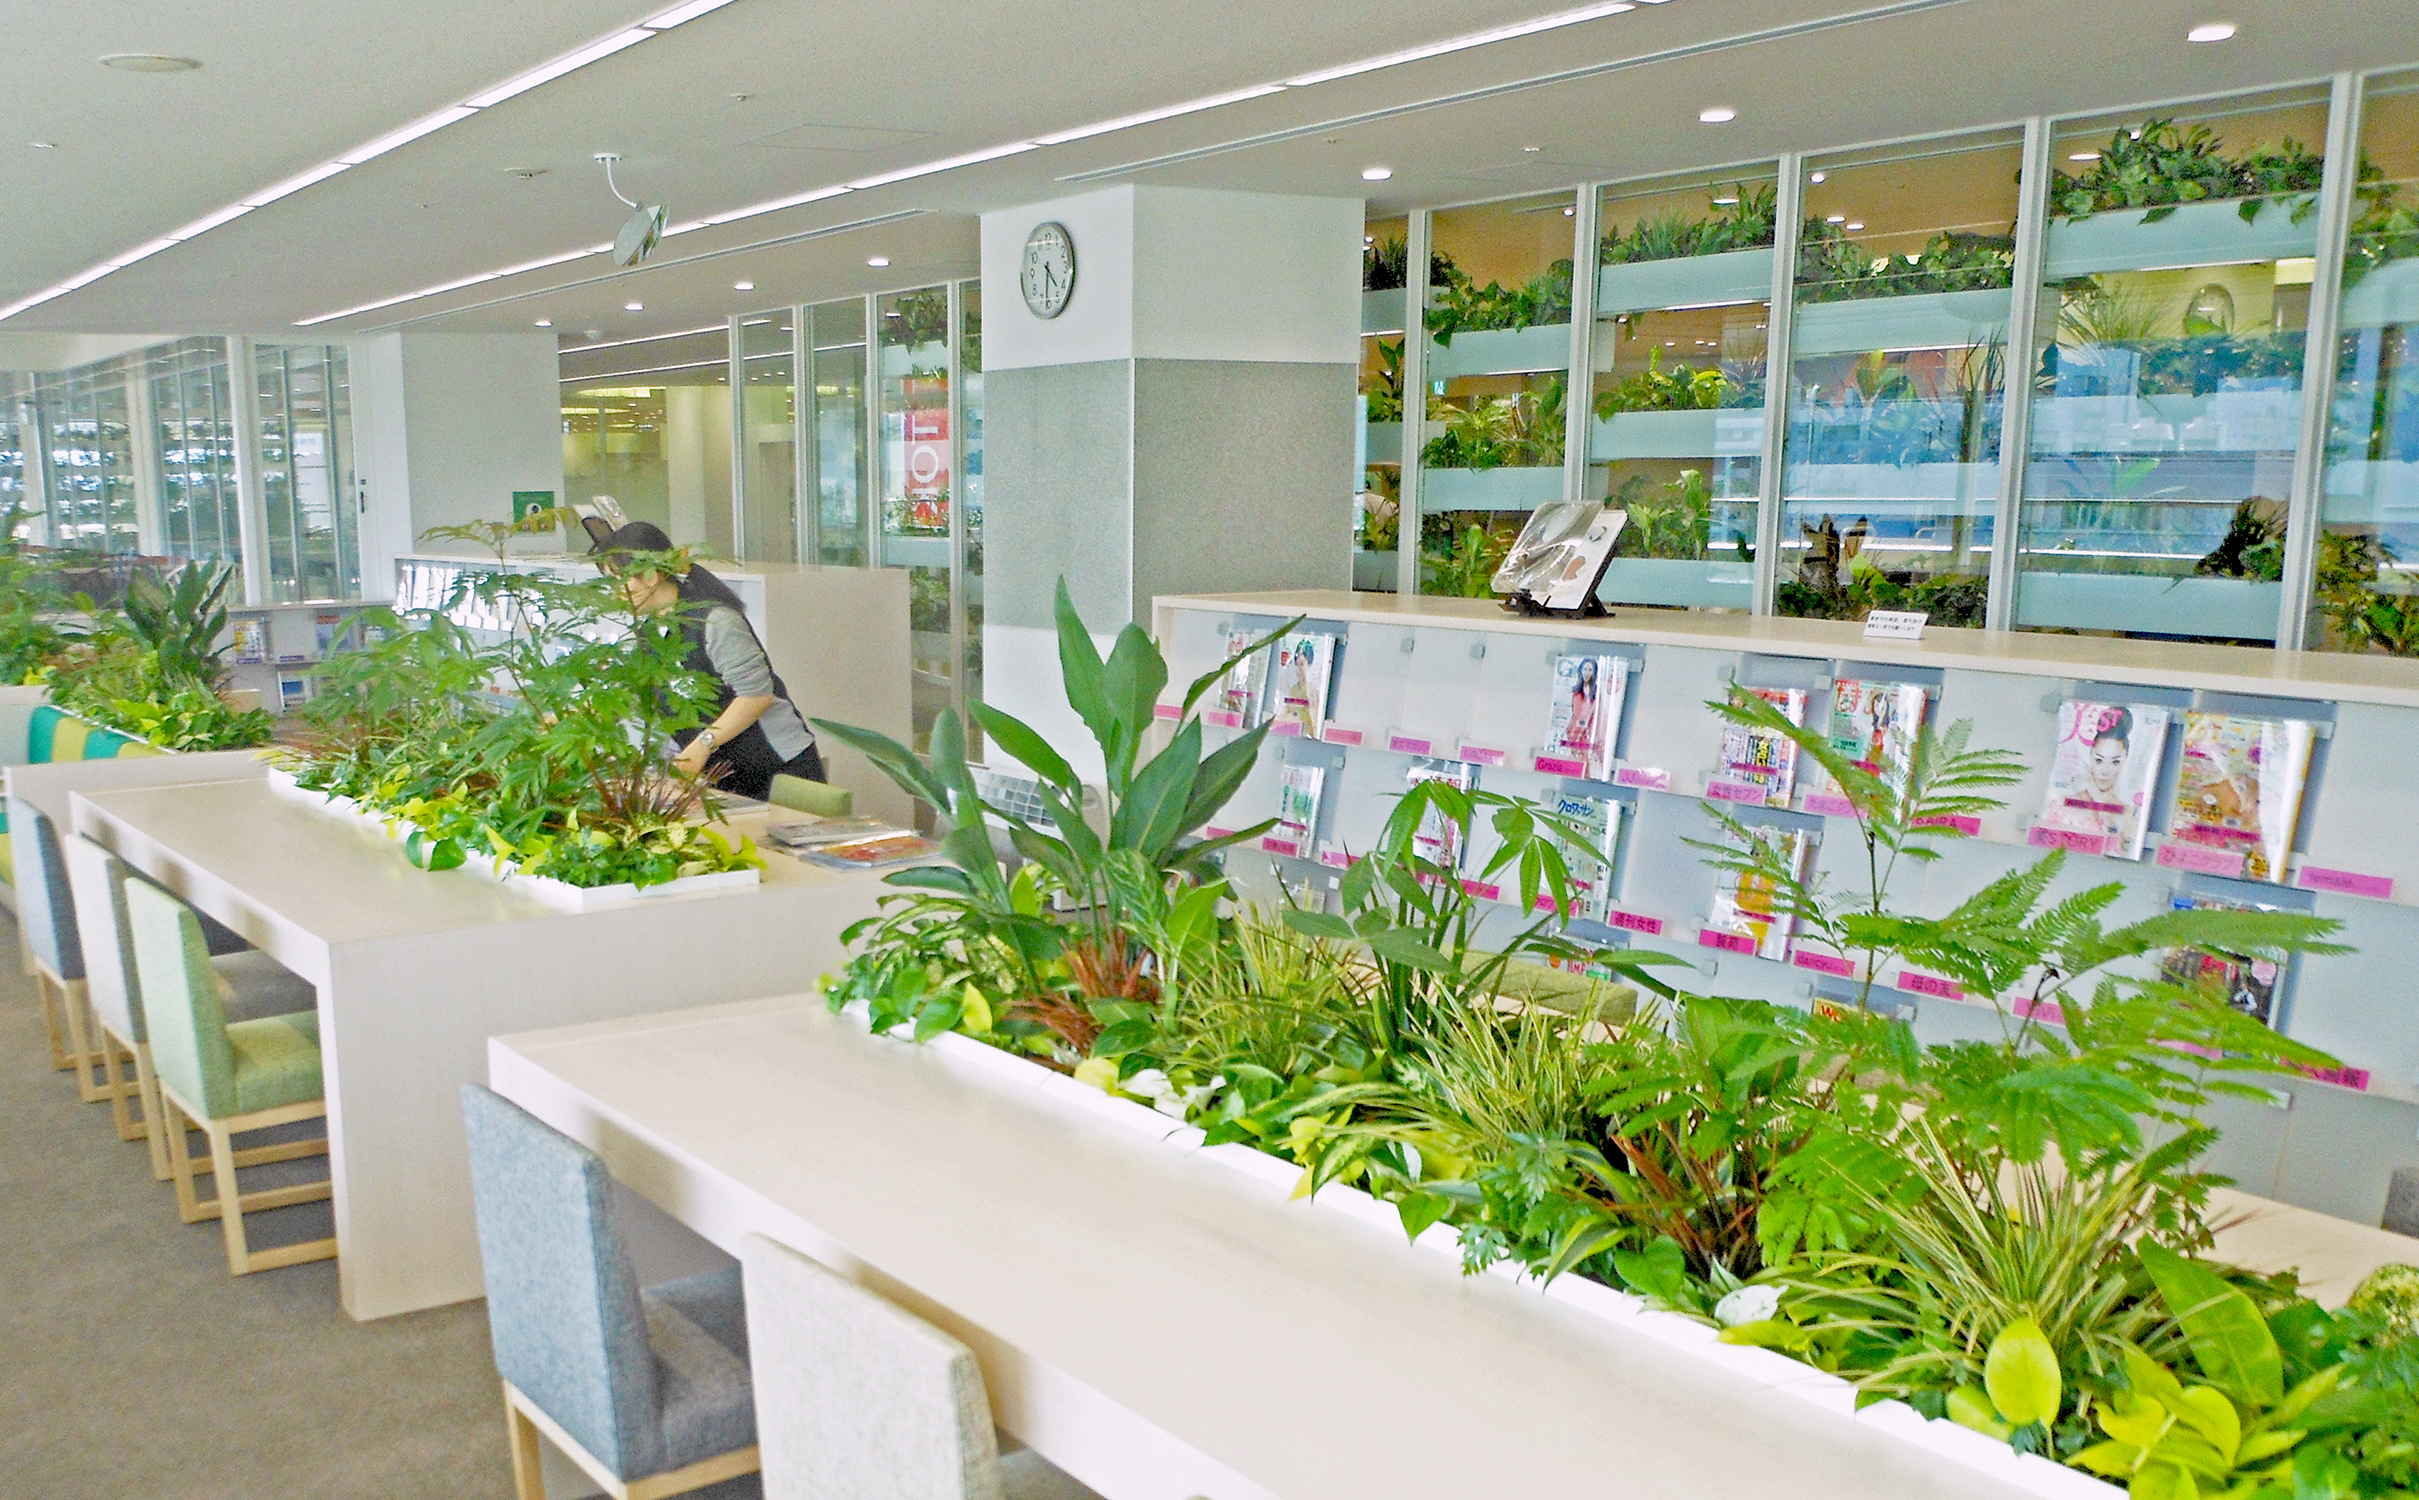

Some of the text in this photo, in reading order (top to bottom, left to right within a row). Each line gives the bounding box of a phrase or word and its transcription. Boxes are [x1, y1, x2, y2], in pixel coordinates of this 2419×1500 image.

[1044, 232, 1052, 245] 12
[1031, 251, 1038, 264] 10
[1060, 245, 1066, 259] 2
[1030, 268, 1035, 279] 9
[1063, 260, 1068, 274] 3
[1032, 283, 1038, 296] 8
[1061, 278, 1066, 289] 4
[1558, 798, 1595, 817] クロワッサン
[1615, 911, 1657, 934] 週刊女性
[1910, 975, 1952, 997] 母の友
